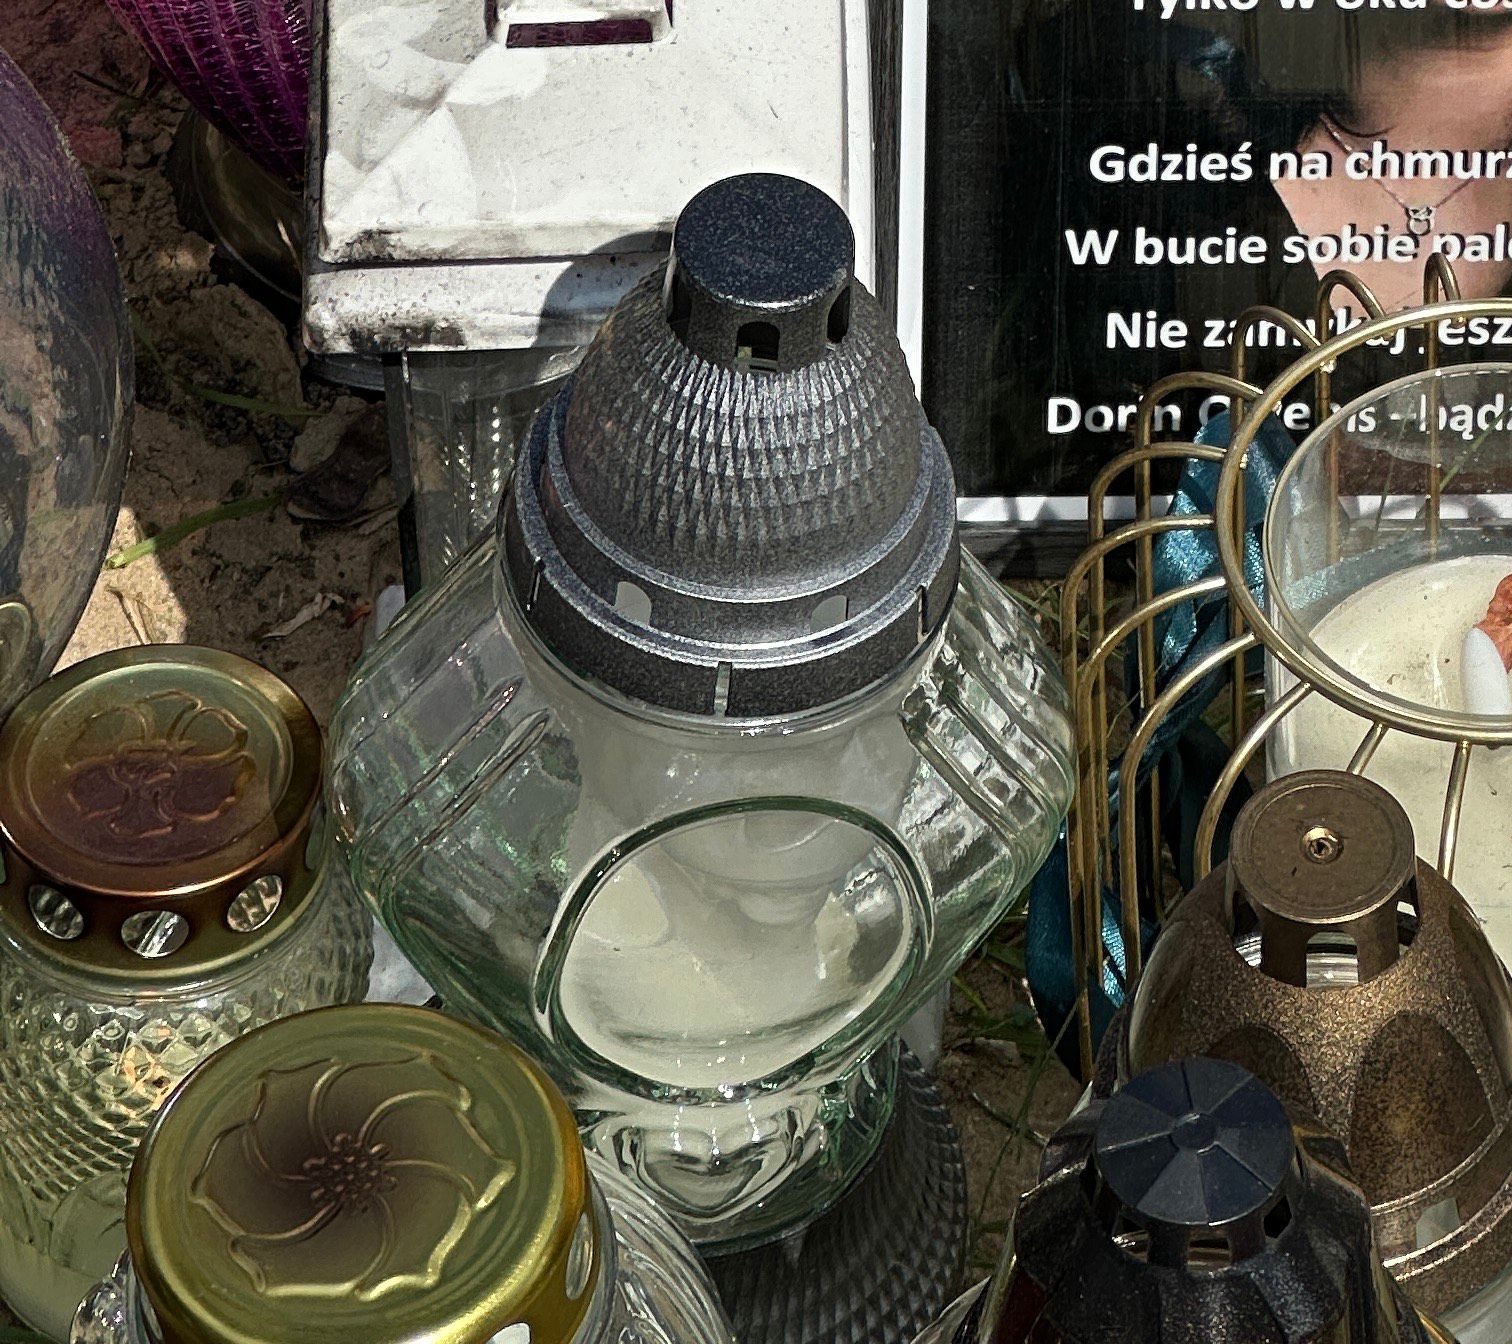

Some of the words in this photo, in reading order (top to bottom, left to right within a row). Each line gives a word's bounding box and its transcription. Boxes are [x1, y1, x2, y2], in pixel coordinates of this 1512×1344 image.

[1088, 140, 1254, 183] Gdzieś
[1269, 150, 1330, 182] na
[1064, 229, 1121, 266] W
[1133, 226, 1270, 266] bucie
[1282, 225, 1420, 266] sobie
[1105, 310, 1188, 349] Nie
[1047, 394, 1182, 435] Dorn
